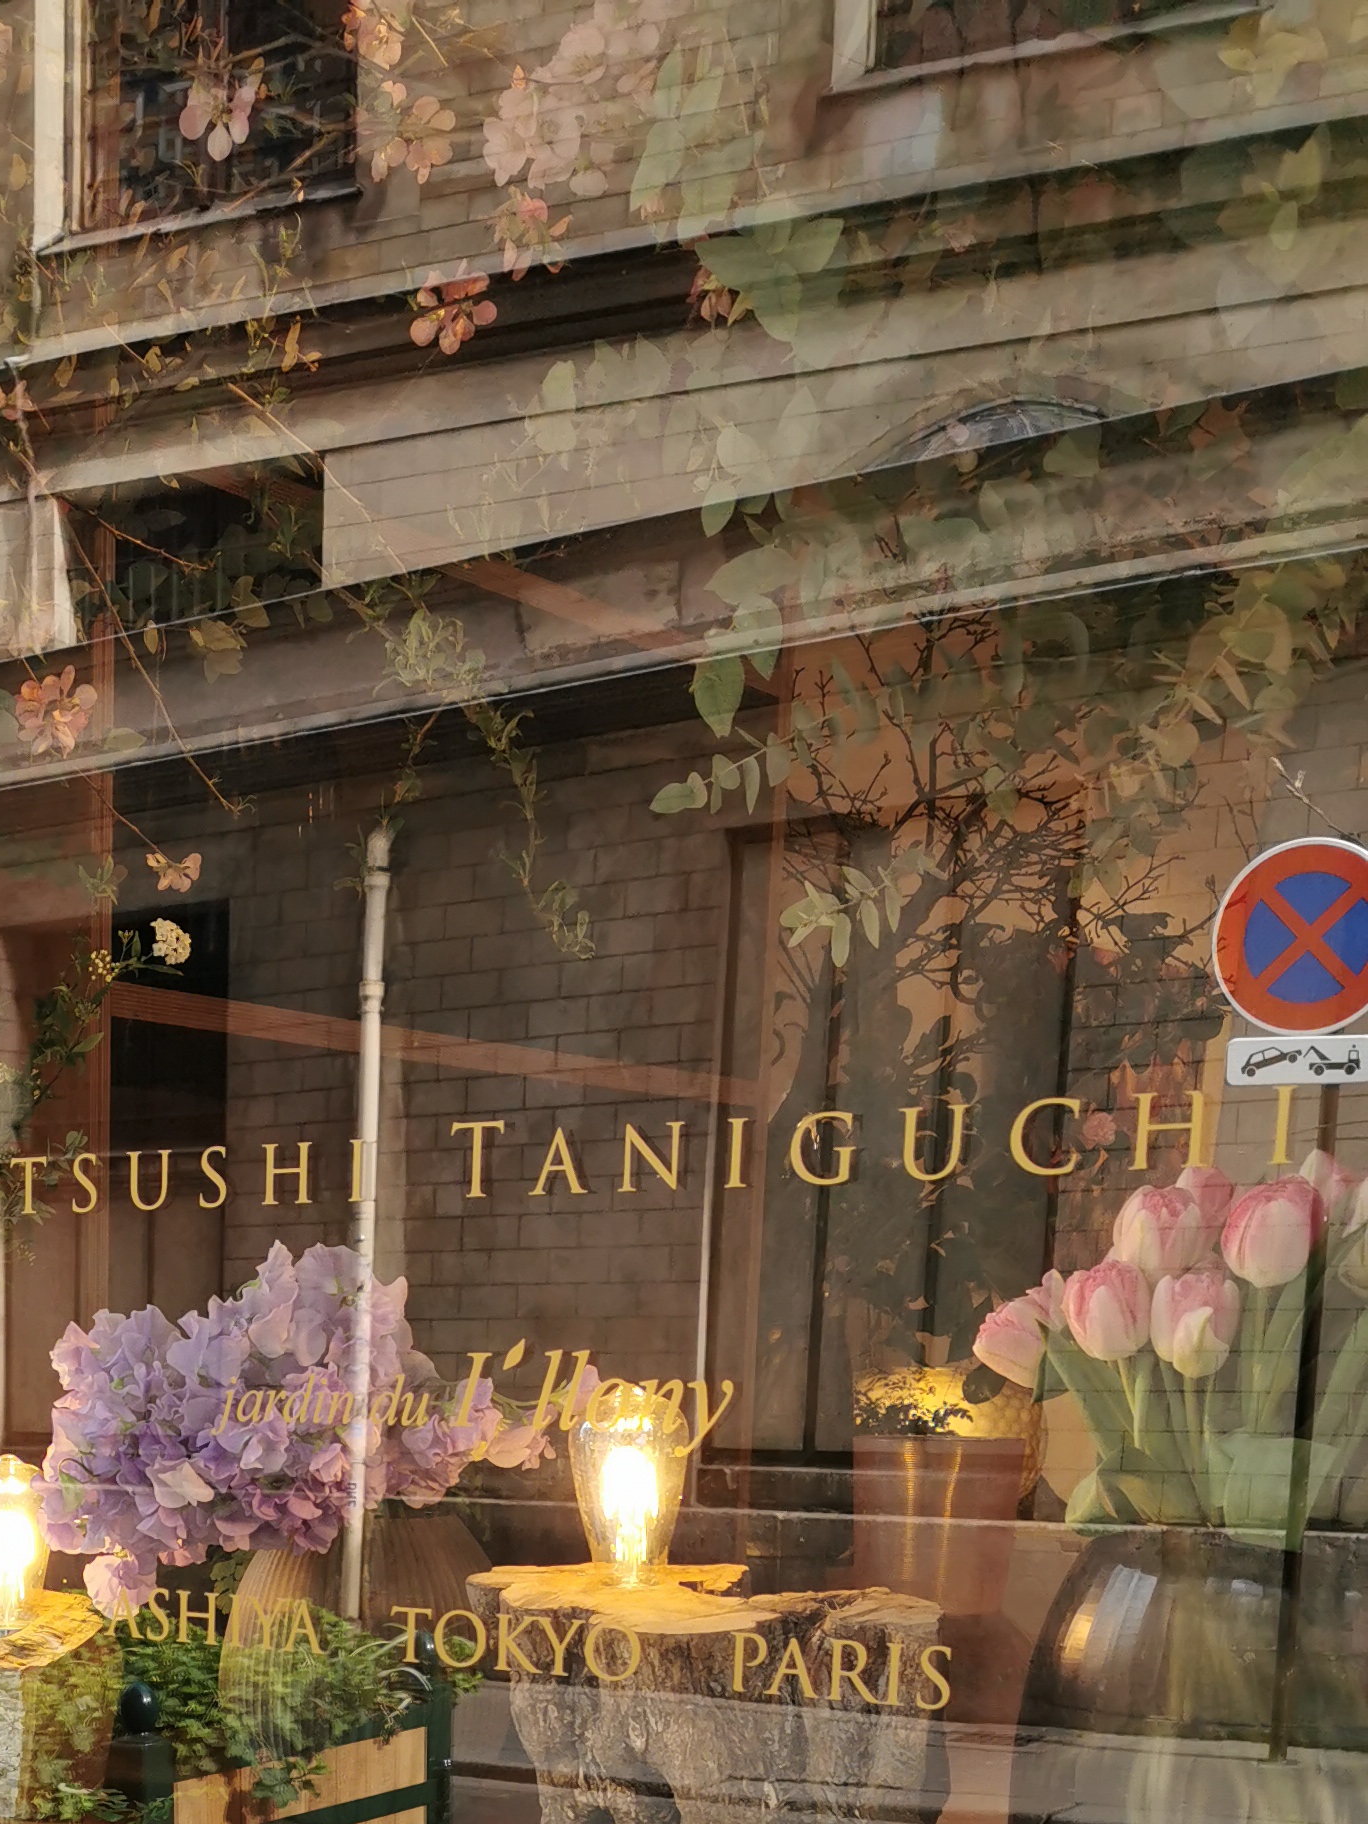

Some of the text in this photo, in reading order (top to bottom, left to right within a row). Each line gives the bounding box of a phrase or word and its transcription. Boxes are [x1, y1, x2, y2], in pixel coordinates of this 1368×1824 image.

[451, 1085, 1297, 1199] TANIGUCHI
[212, 1376, 354, 1437] jardin
[370, 1375, 429, 1427] du
[104, 1586, 953, 1710] ASHIYA TOKYO PARIS
